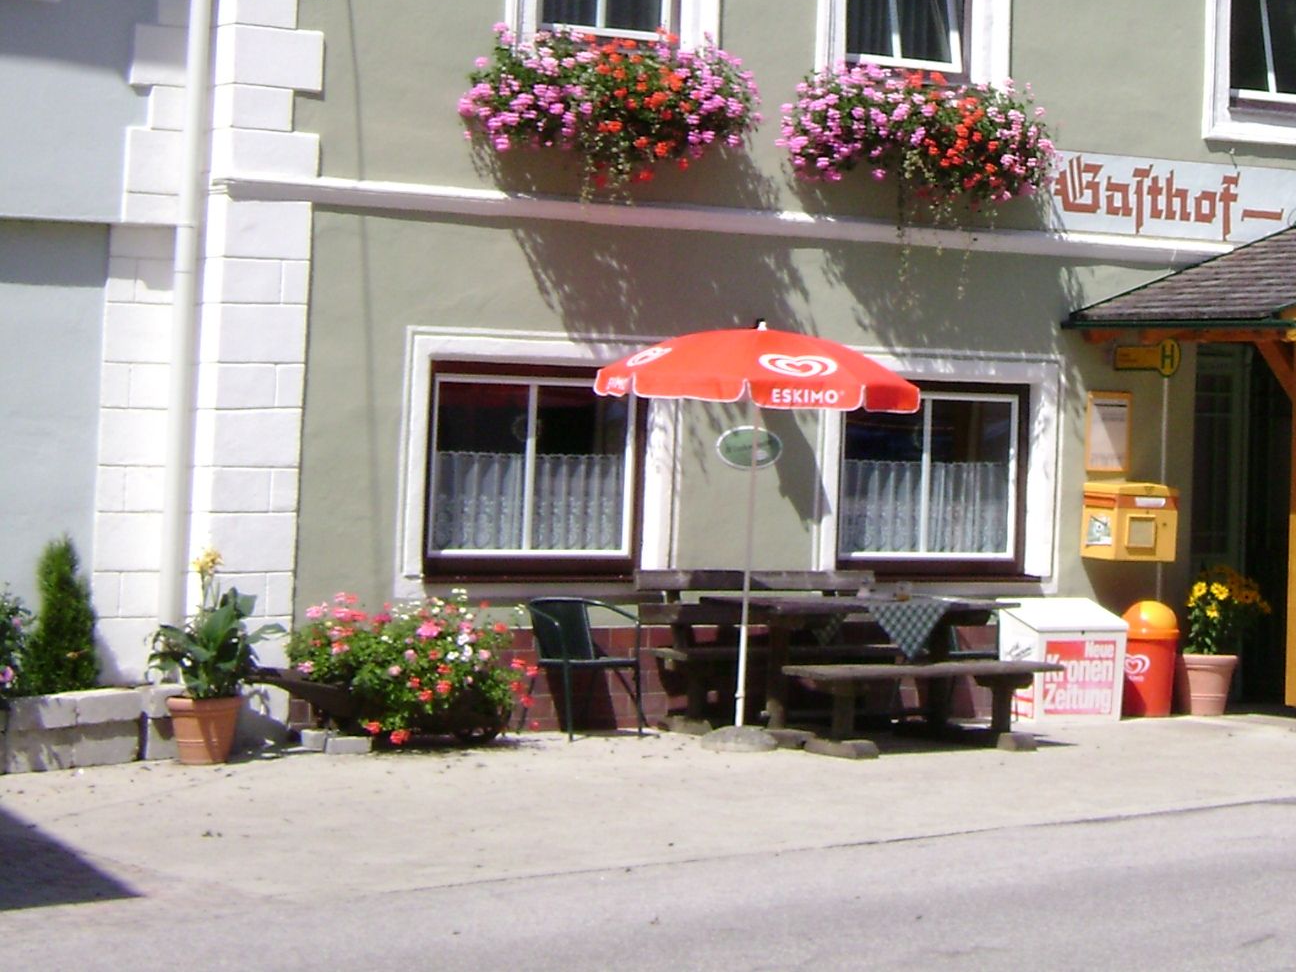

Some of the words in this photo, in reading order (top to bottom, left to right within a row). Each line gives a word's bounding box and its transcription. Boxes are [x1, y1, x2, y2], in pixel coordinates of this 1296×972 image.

[1161, 343, 1175, 369] H
[771, 387, 839, 405] ESKIMO
[1085, 641, 1114, 658] Neue
[1044, 683, 1112, 713] Zeitung
